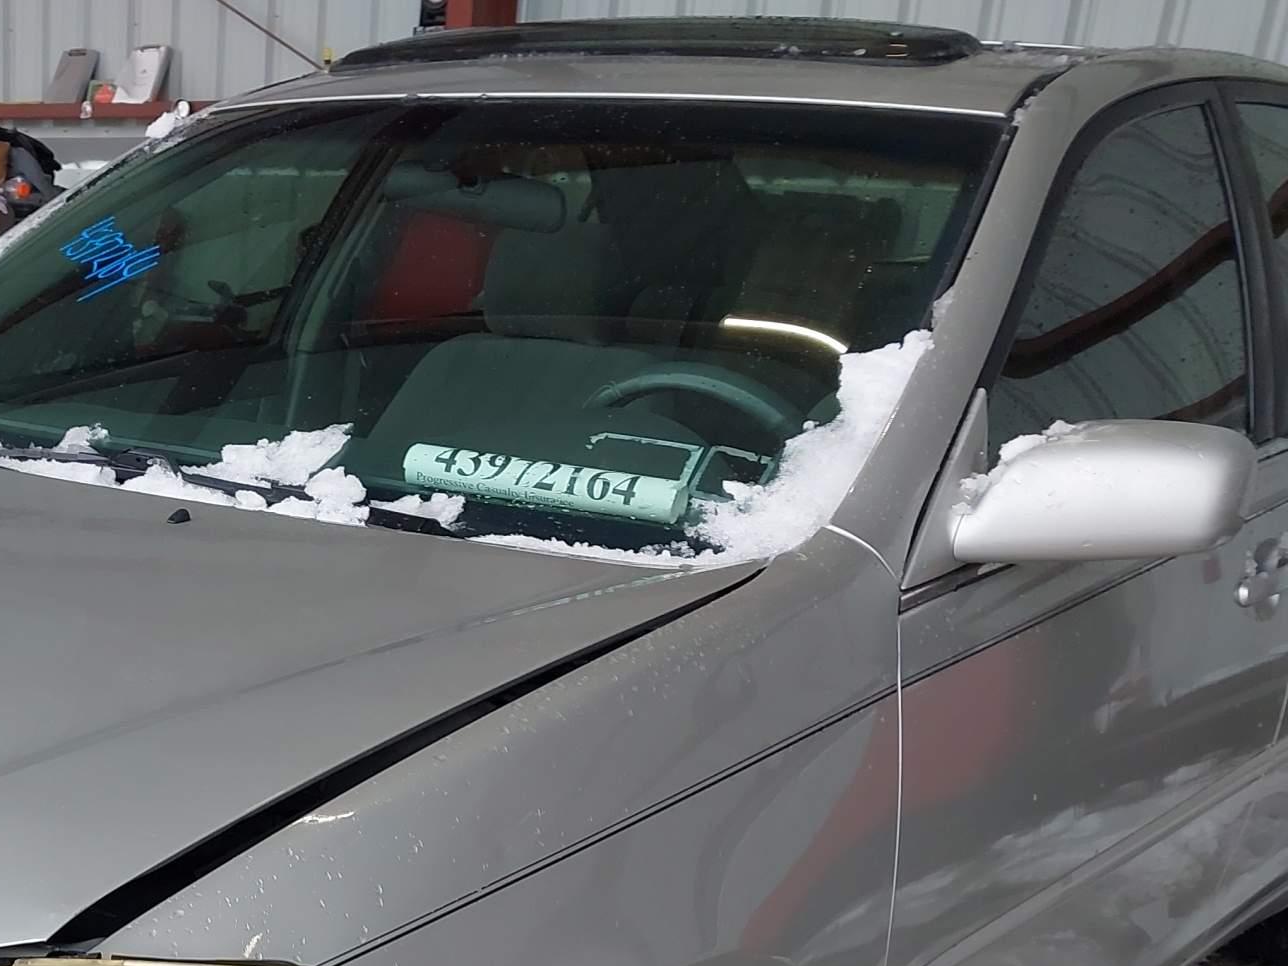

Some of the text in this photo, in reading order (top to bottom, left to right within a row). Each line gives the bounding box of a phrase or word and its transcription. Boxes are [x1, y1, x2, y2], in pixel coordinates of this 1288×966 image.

[416, 471, 474, 490] Progressive
[477, 483, 522, 499] Casualty
[435, 447, 641, 506] 43972164
